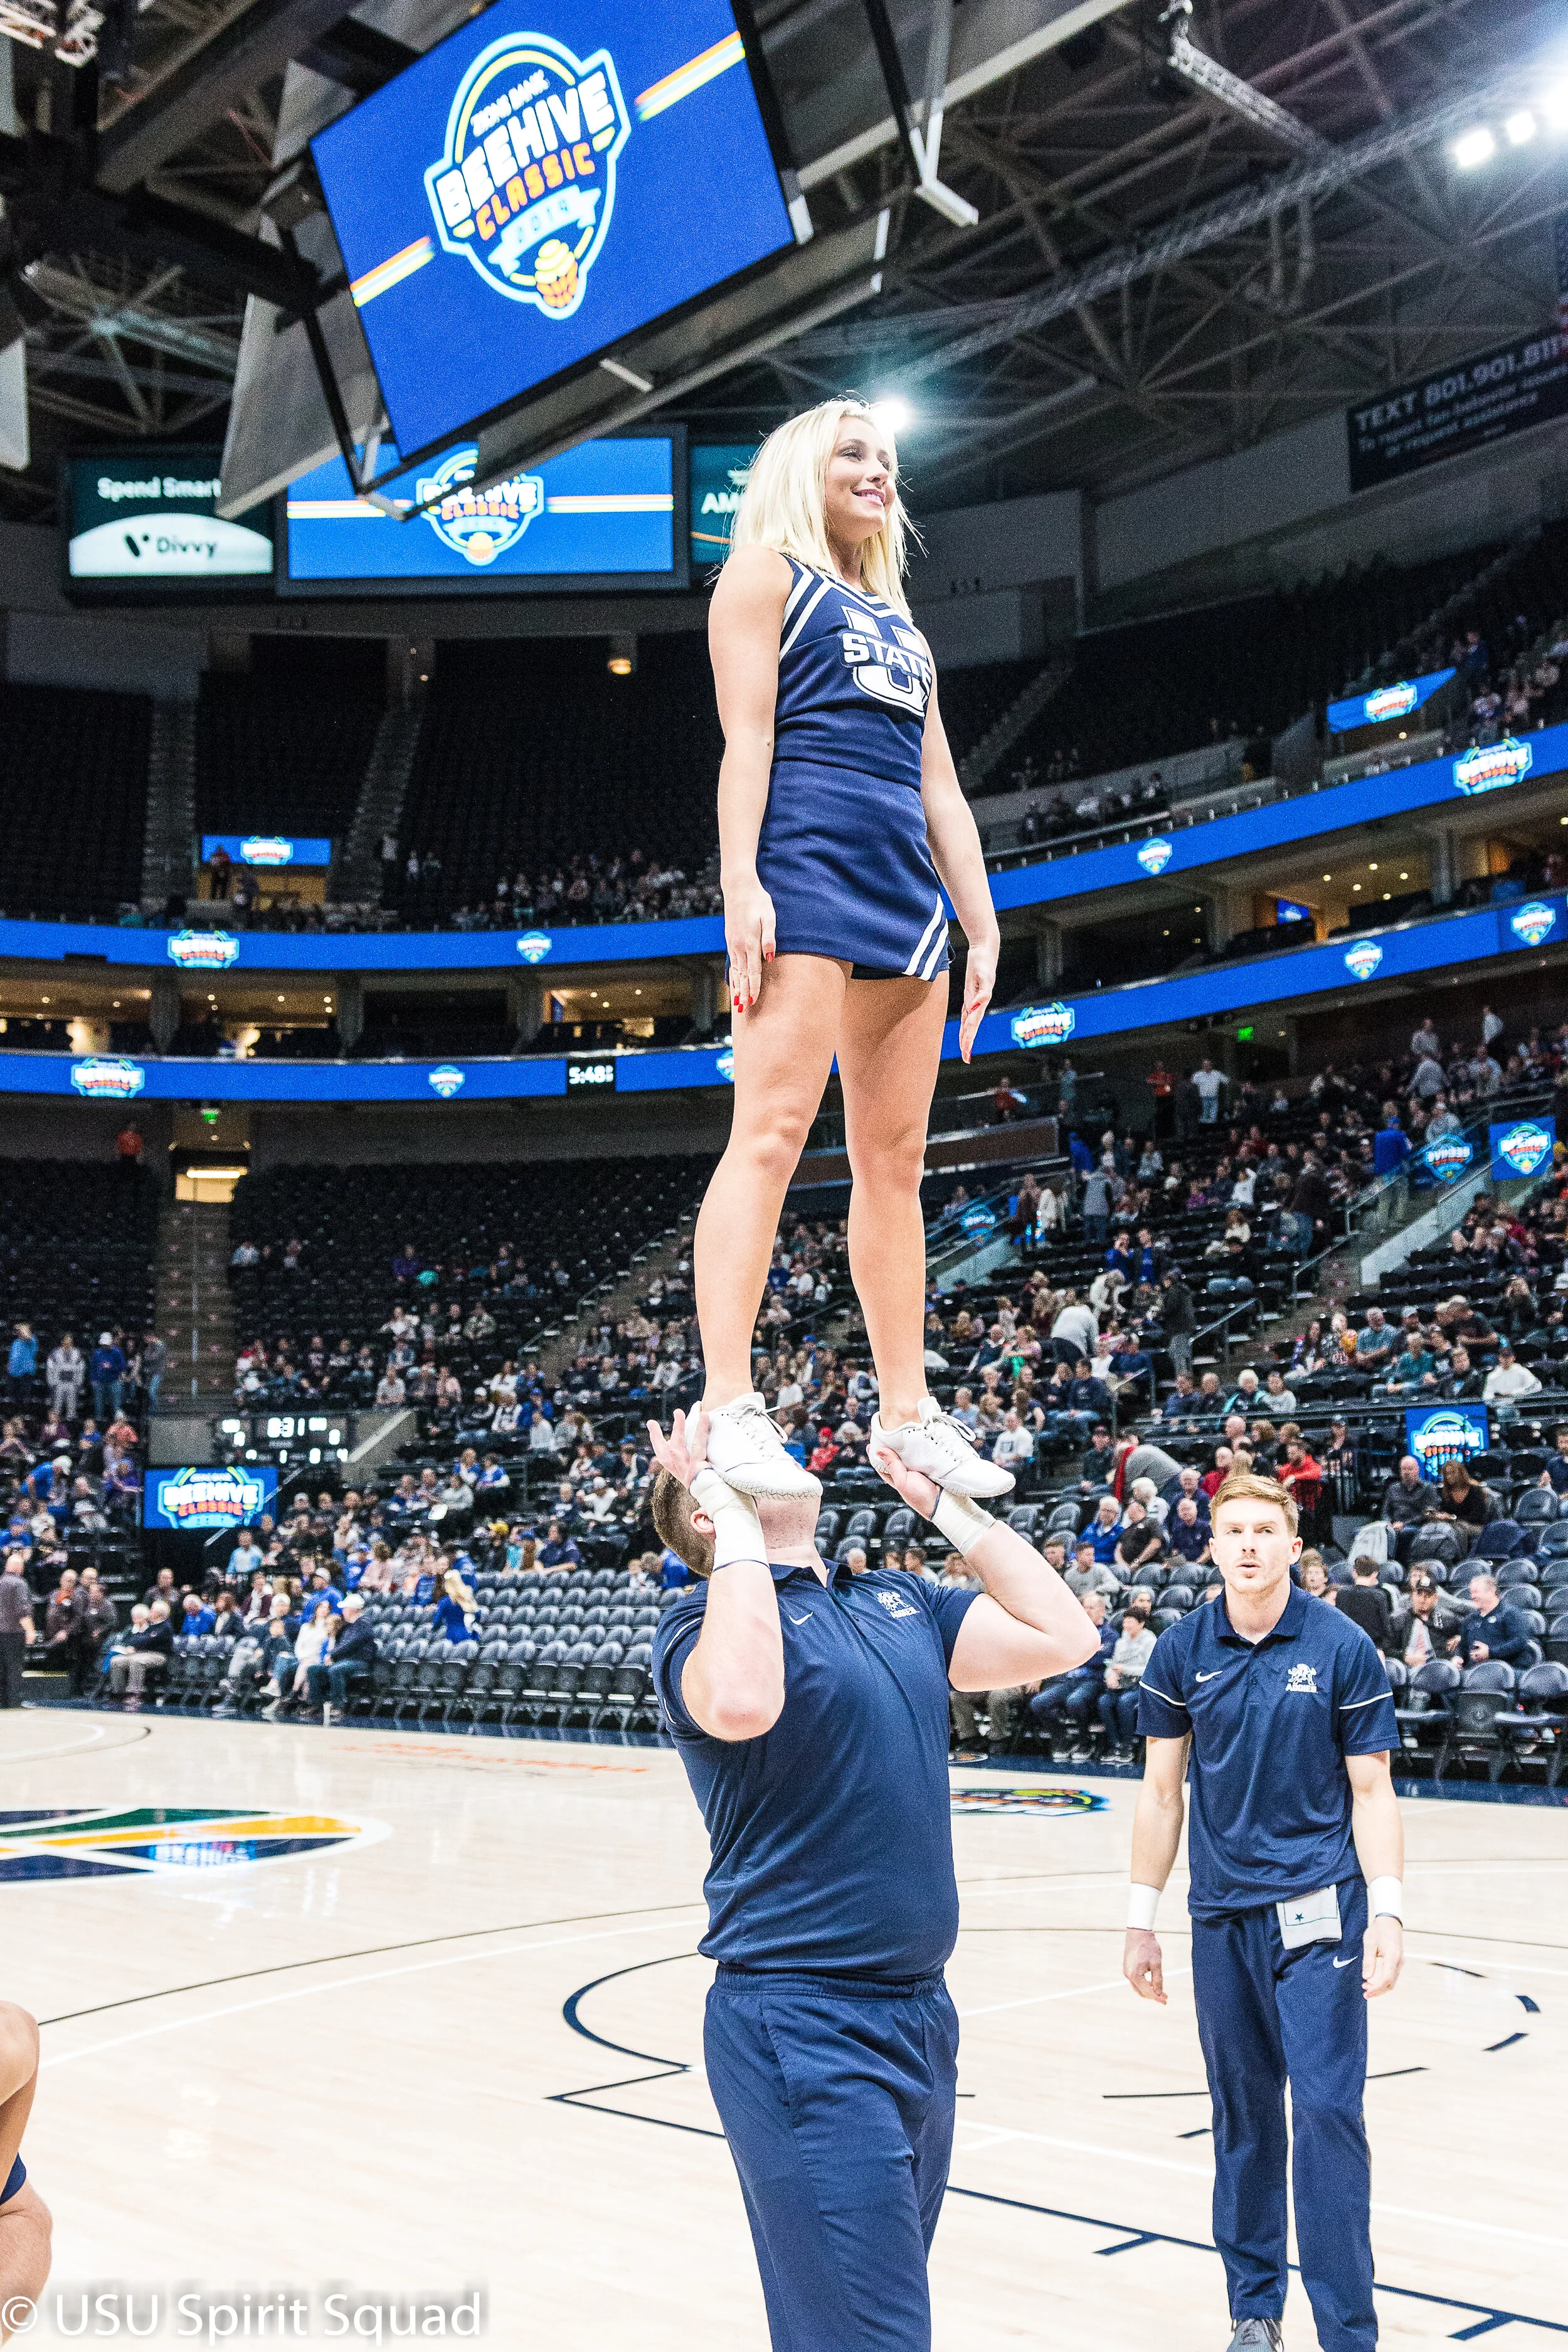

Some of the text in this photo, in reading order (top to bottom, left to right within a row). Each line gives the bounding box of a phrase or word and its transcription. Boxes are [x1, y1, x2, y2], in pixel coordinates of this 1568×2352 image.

[436, 71, 615, 228] BEEHIVE
[475, 142, 595, 241] CLASSIC
[1355, 390, 1417, 432] TEXT
[97, 477, 161, 502] Spend
[441, 501, 519, 521] CLASSIC
[157, 536, 216, 559] Divvy
[842, 632, 933, 697] STATE
[164, 1481, 259, 1506] BEEHIVE
[178, 1500, 243, 1517] CLASSIC
